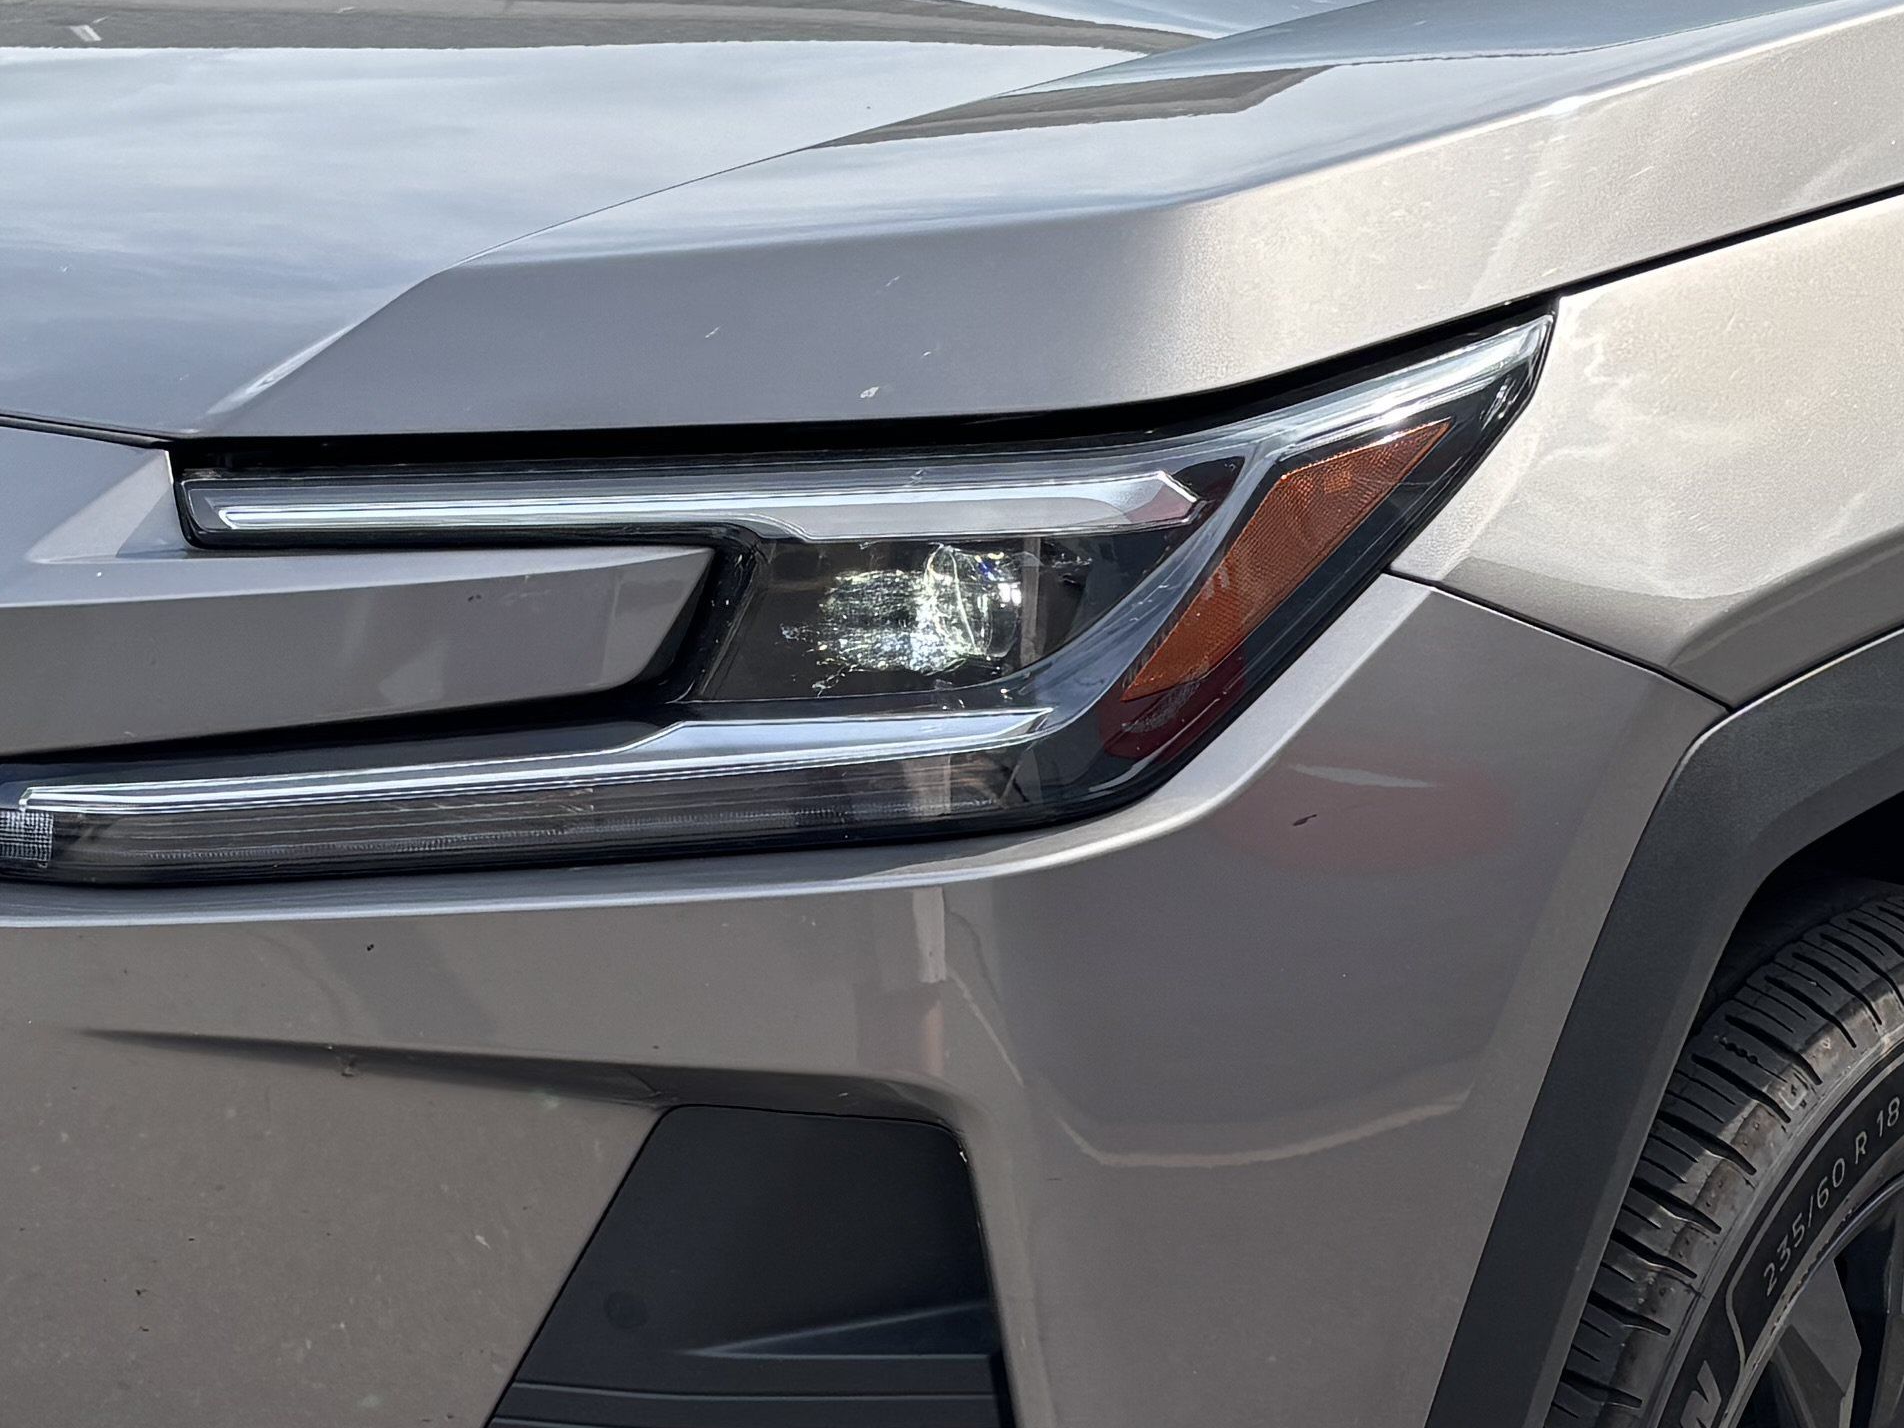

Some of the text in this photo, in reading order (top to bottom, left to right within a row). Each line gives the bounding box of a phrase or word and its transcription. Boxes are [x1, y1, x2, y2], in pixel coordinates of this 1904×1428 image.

[1763, 1096, 1901, 1297] 235/60 R 18
